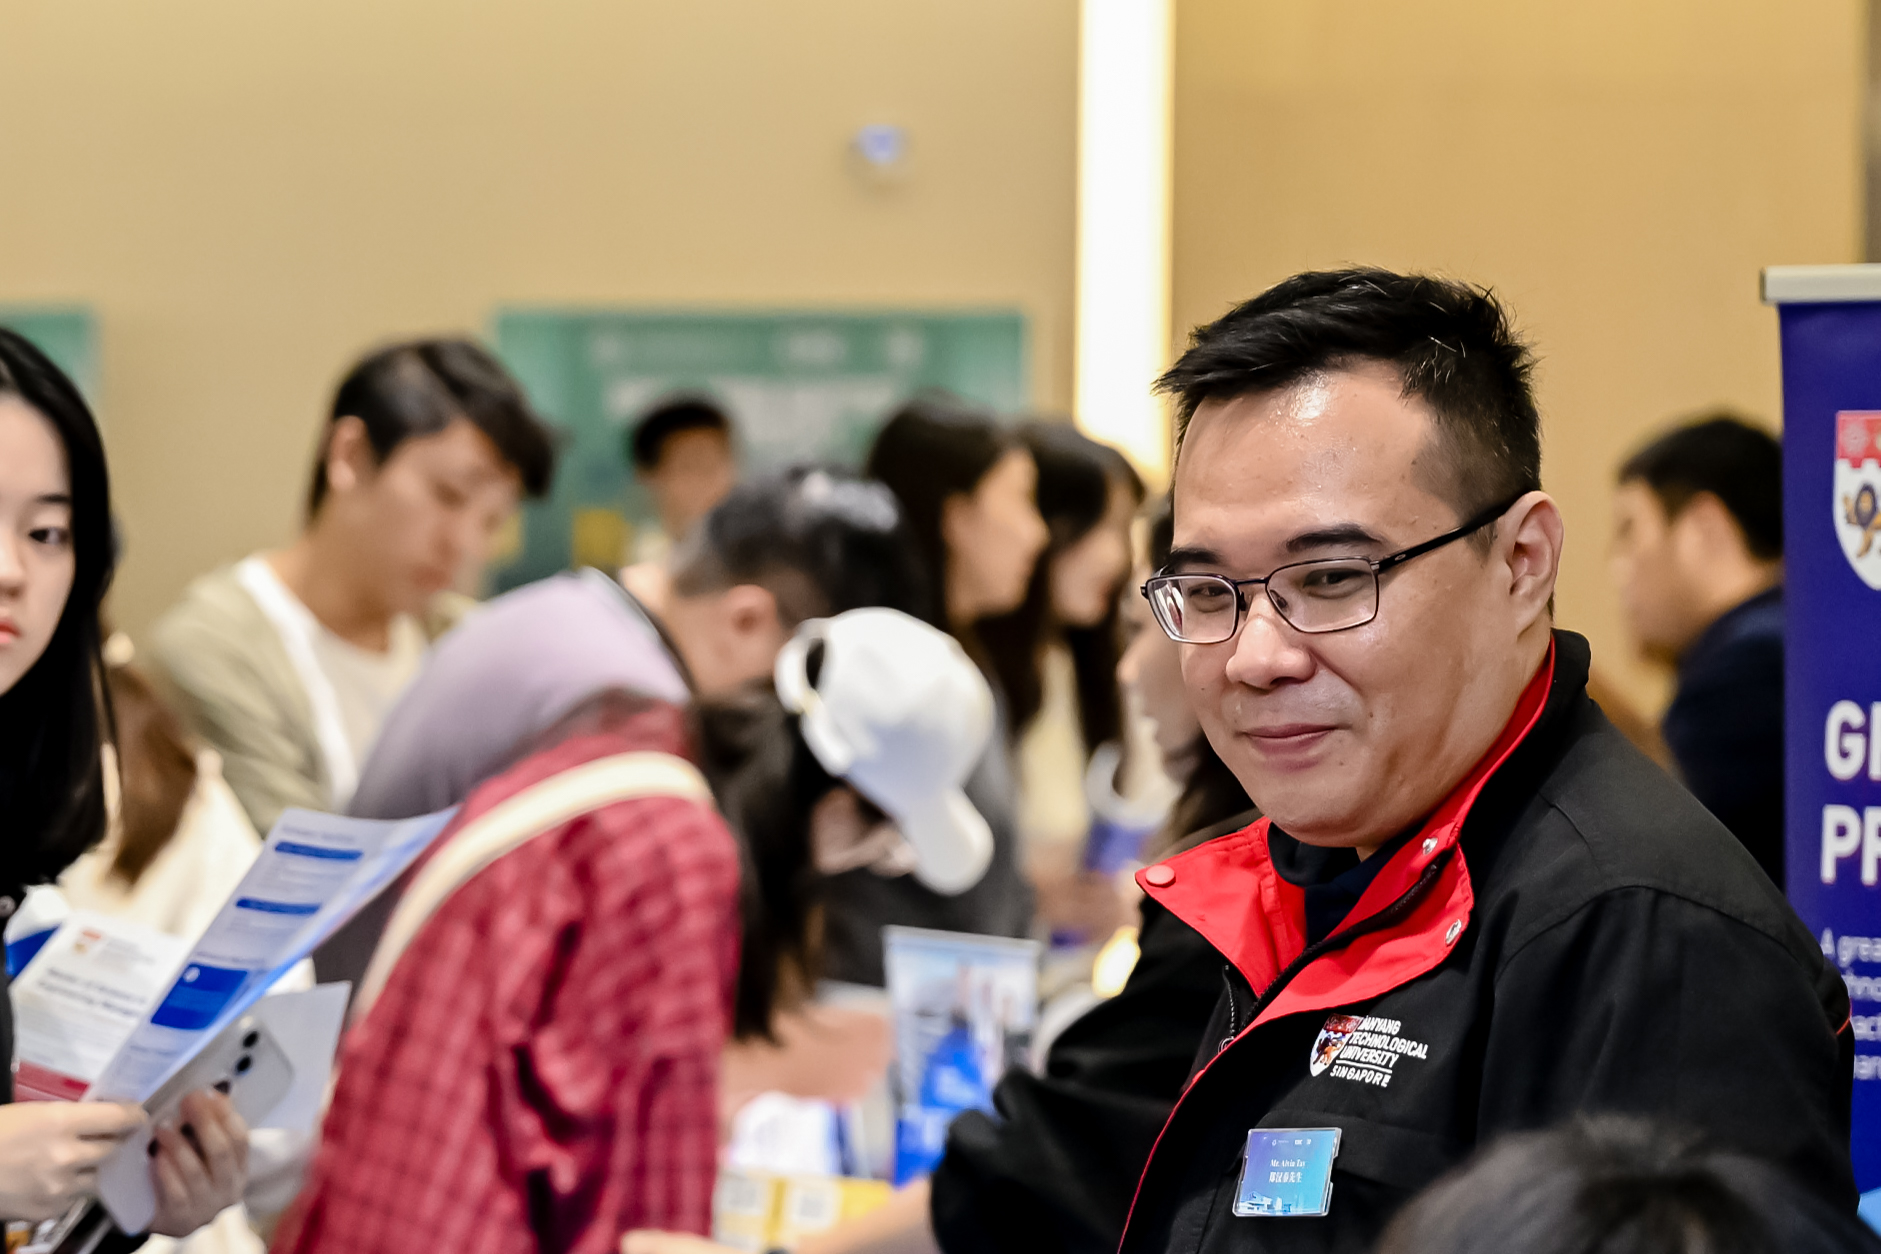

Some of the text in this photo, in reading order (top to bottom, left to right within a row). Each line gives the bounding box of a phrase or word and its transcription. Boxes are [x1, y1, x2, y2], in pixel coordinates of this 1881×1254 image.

[1824, 699, 1881, 781] G
[1339, 1045, 1399, 1068] UNIVERSITY
[1348, 1031, 1428, 1060] TECHNOLOGICAL
[1330, 1064, 1391, 1088] SINGAPORE
